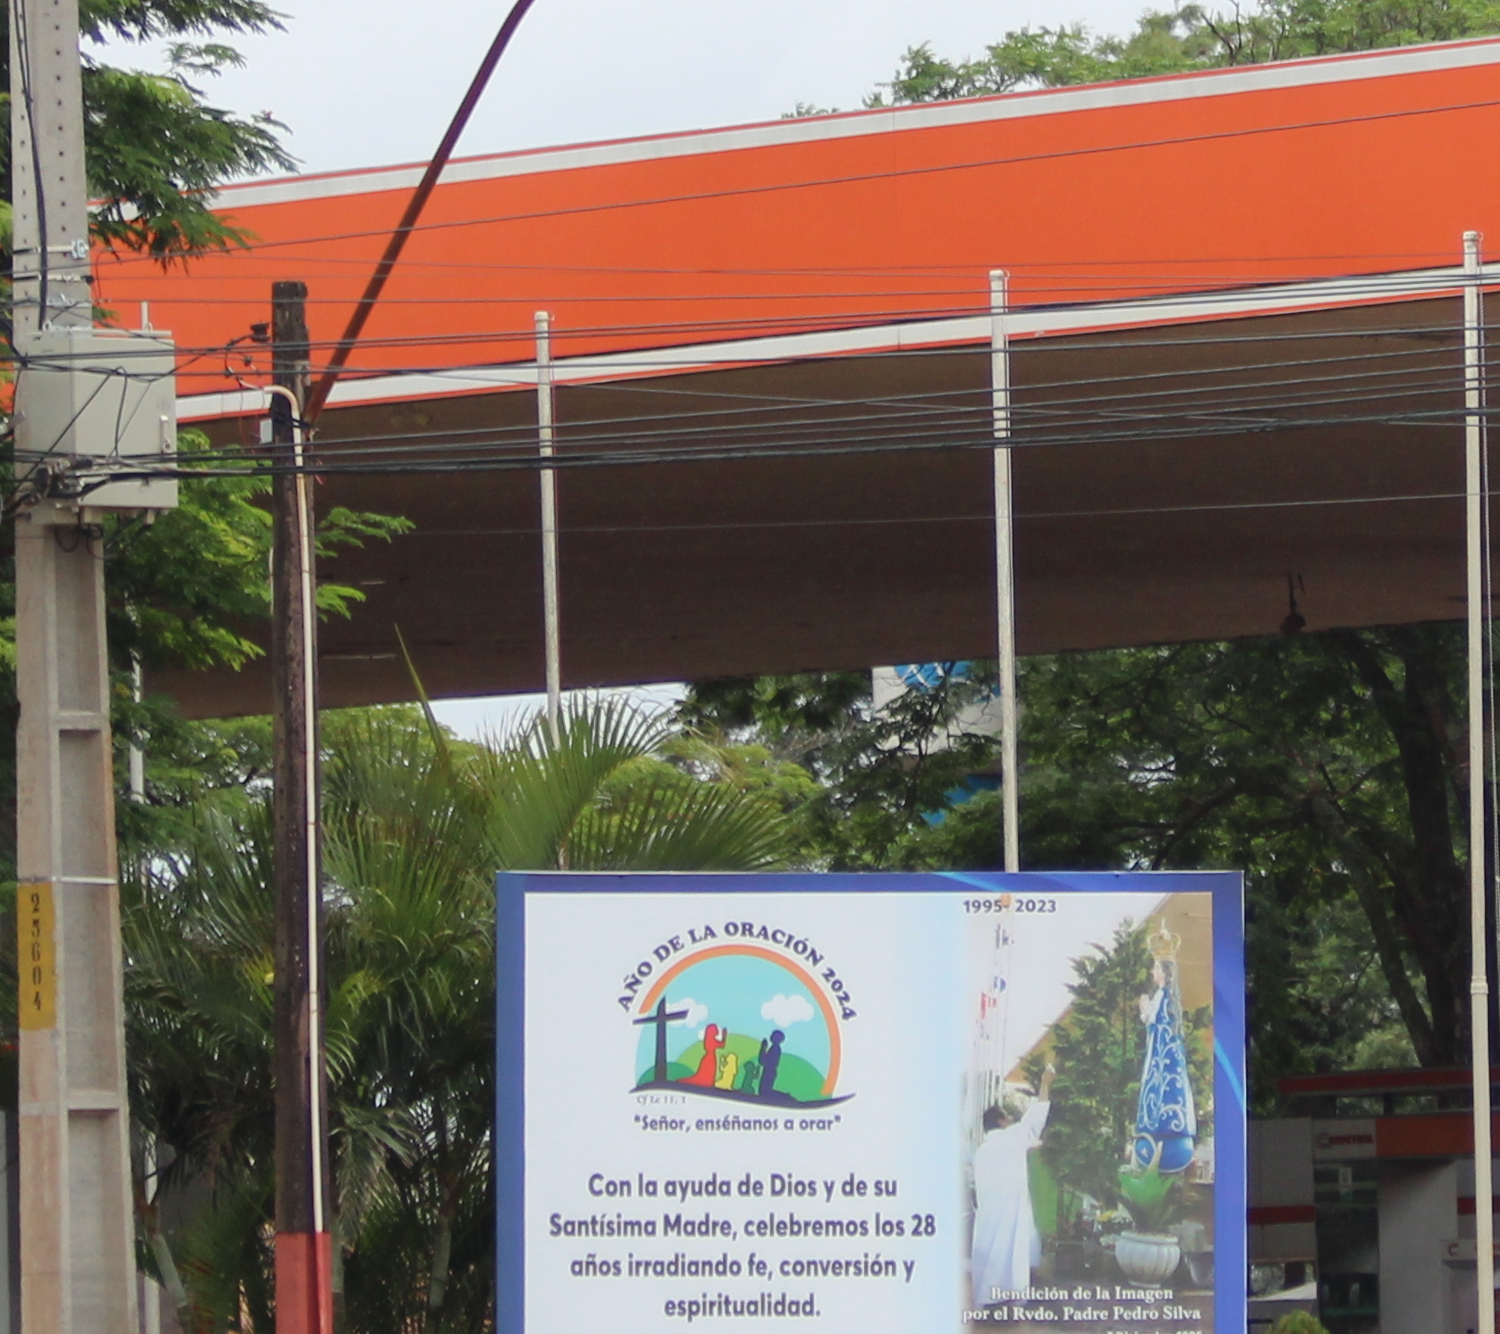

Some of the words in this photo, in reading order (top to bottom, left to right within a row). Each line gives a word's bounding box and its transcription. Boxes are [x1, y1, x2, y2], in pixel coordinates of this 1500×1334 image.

[1015, 899, 1057, 913] 2023
[617, 961, 653, 1012] AÑO
[652, 935, 685, 964] DE
[688, 925, 717, 945] LA
[724, 921, 824, 967] ORACIÓN
[821, 967, 857, 1020] 2024
[695, 1114, 780, 1132] enséñanos
[784, 1119, 794, 1131] a
[588, 1173, 631, 1198] Con
[638, 1173, 657, 1197] la
[664, 1173, 732, 1203] ayuda
[737, 1173, 763, 1197] de
[770, 1173, 817, 1197] Dios
[823, 1178, 835, 1202] y
[841, 1173, 867, 1197] de
[873, 1179, 898, 1197] su
[549, 1212, 657, 1237] Santísima
[663, 1212, 737, 1241] Madre,
[744, 1212, 869, 1237] celebremos
[875, 1212, 905, 1237] los
[911, 1213, 937, 1237] 28
[570, 1254, 622, 1277] años
[628, 1253, 742, 1277] irradiando
[748, 1253, 773, 1281] fe,
[779, 1253, 897, 1277] conversión
[903, 1259, 915, 1283] y
[664, 1292, 821, 1323] espiritualidad.
[991, 1286, 1069, 1301] Bendición
[1073, 1286, 1092, 1300] de
[1096, 1285, 1111, 1300] la
[1114, 1286, 1173, 1303] Imagen
[962, 1308, 990, 1324] por
[994, 1306, 1008, 1321] el
[1013, 1306, 1059, 1321] Rvdo.
[1063, 1306, 1109, 1321] Padre
[1113, 1306, 1160, 1321] Pedro
[1162, 1305, 1202, 1320] Silva
